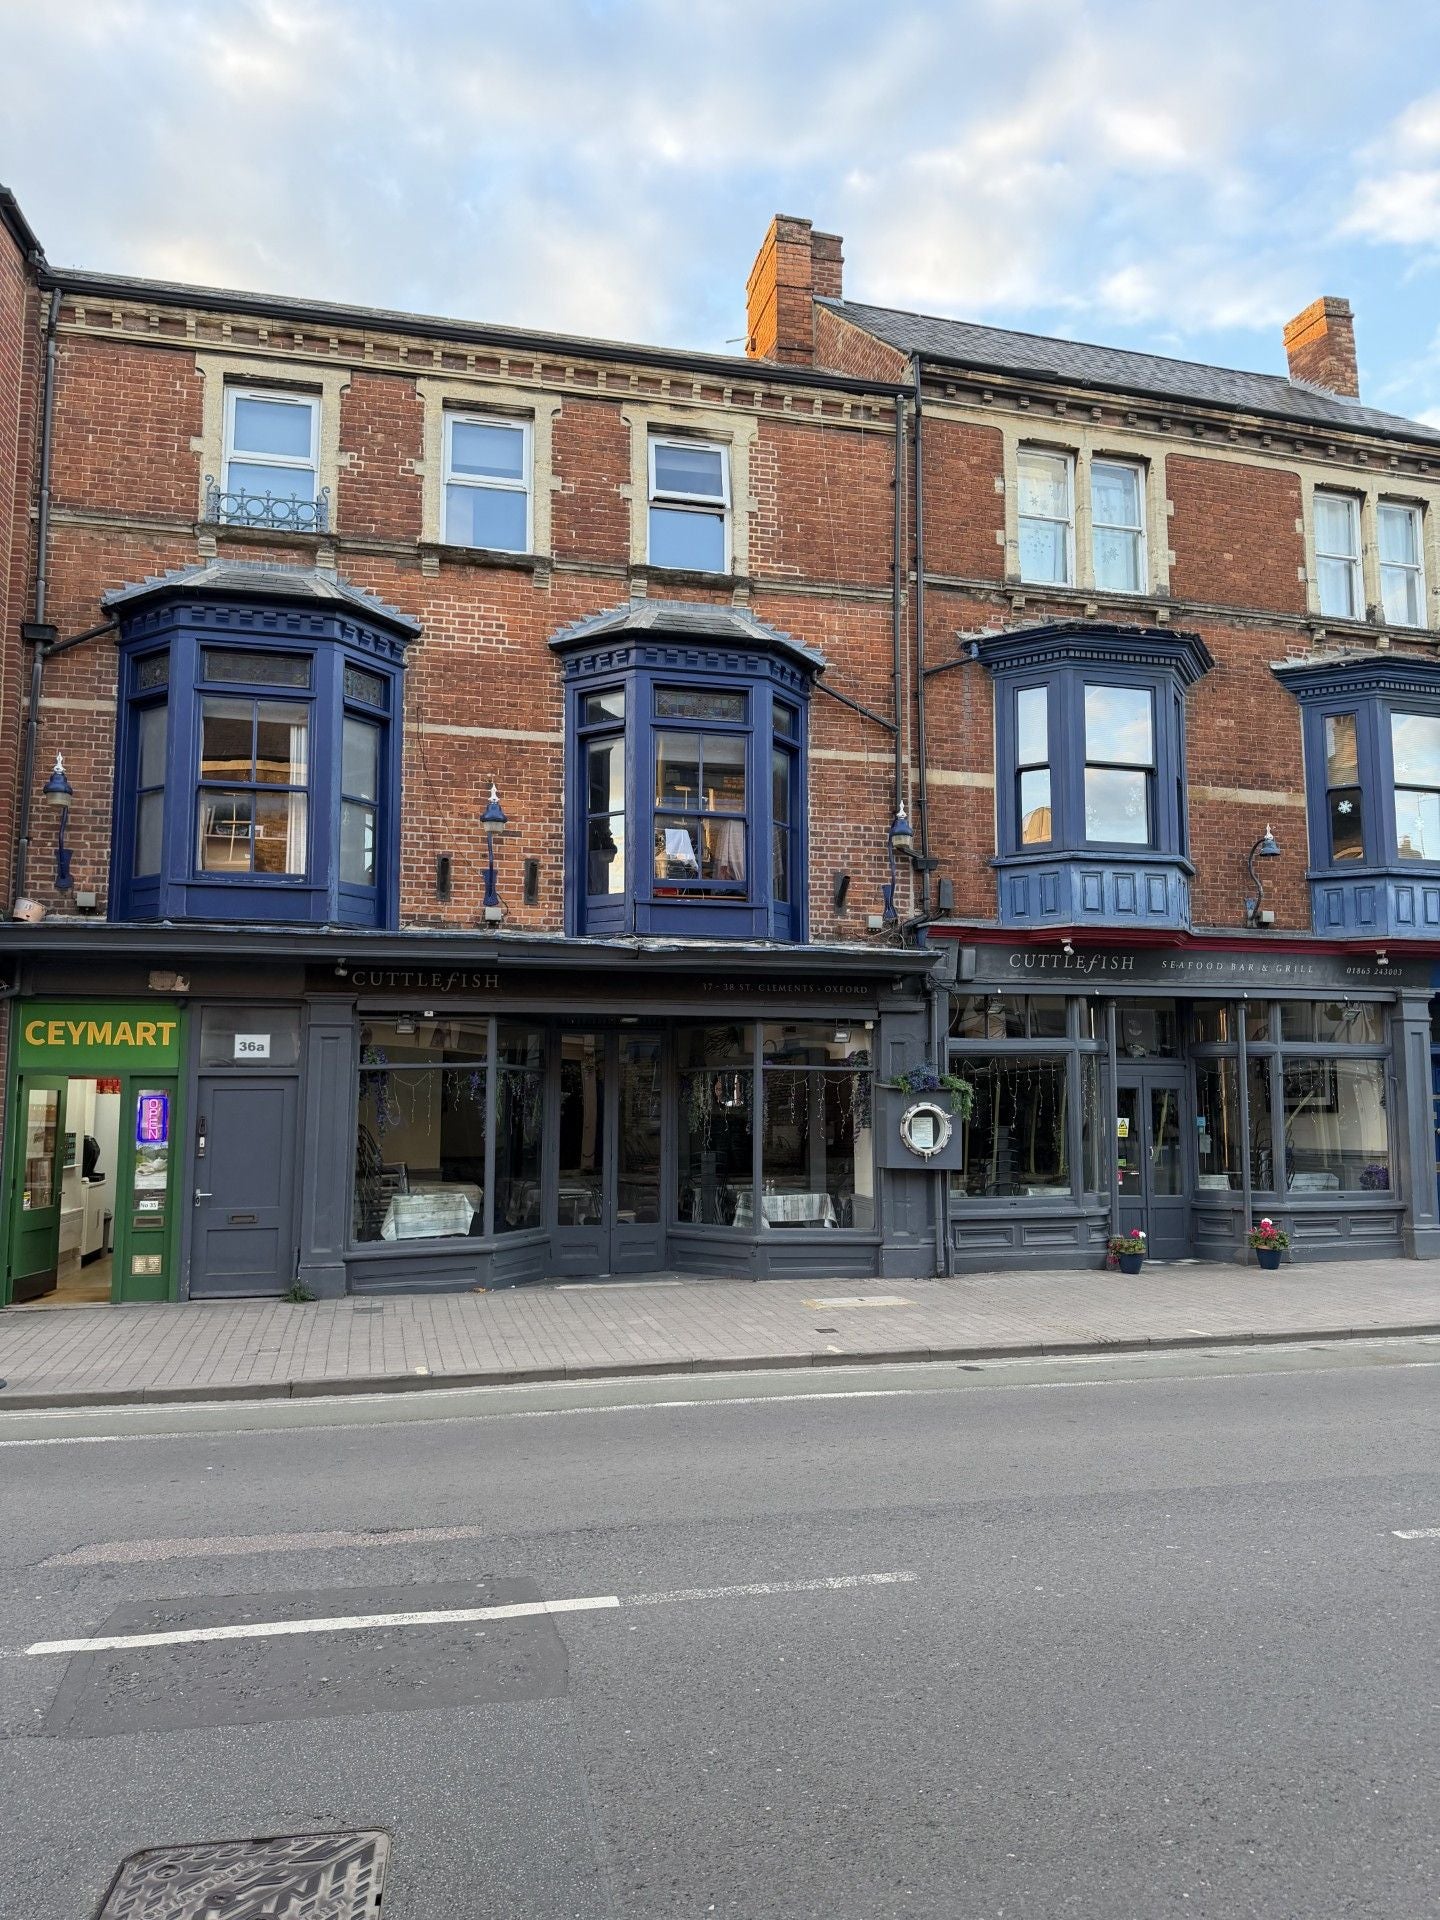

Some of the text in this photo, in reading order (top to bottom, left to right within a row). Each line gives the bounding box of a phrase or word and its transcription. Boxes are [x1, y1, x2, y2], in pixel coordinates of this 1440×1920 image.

[1161, 960, 1314, 974] SEAFOOD BAR & GRILL
[758, 984, 814, 993] CLEMENTS
[824, 985, 868, 994] OXFORD
[25, 1020, 177, 1046] CEYMART
[239, 1041, 265, 1052] 36a
[148, 1099, 158, 1140] OPEN
